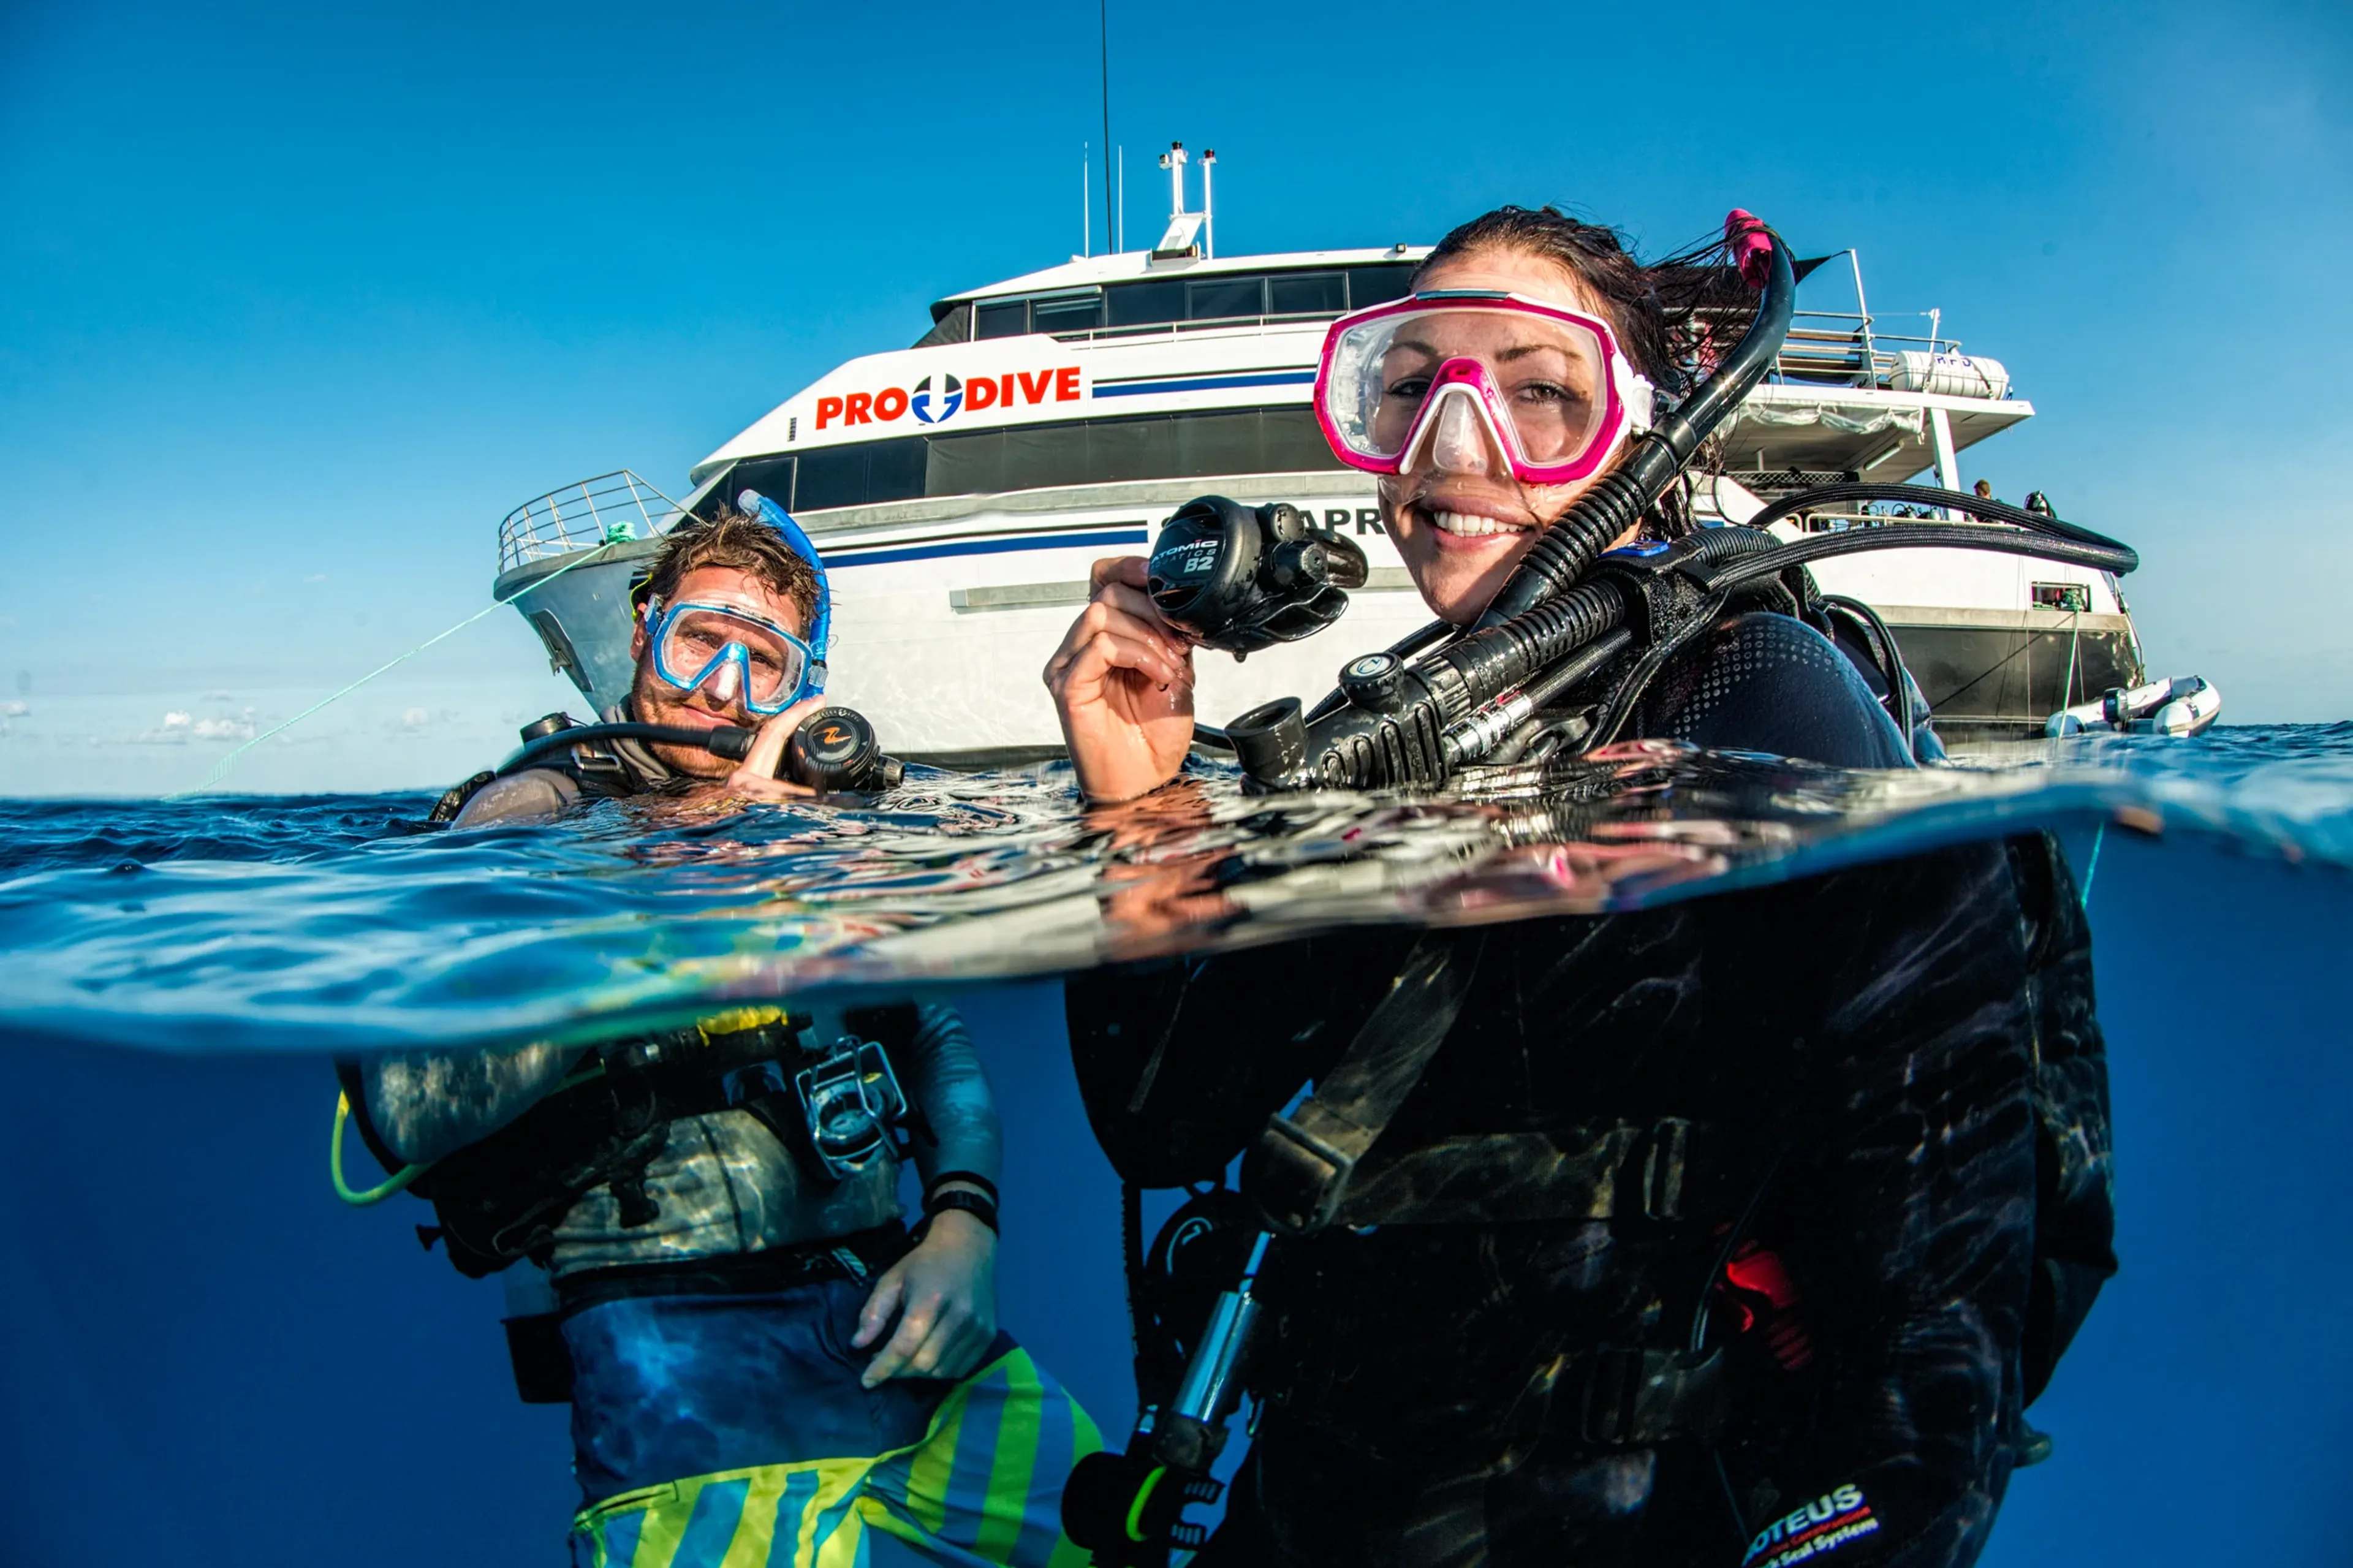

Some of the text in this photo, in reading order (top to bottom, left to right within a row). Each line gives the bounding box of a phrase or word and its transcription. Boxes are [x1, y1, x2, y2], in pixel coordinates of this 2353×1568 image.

[816, 366, 1080, 430] PRO DIVE
[1183, 556, 1214, 573] B2
[1813, 1518, 1879, 1549] System
